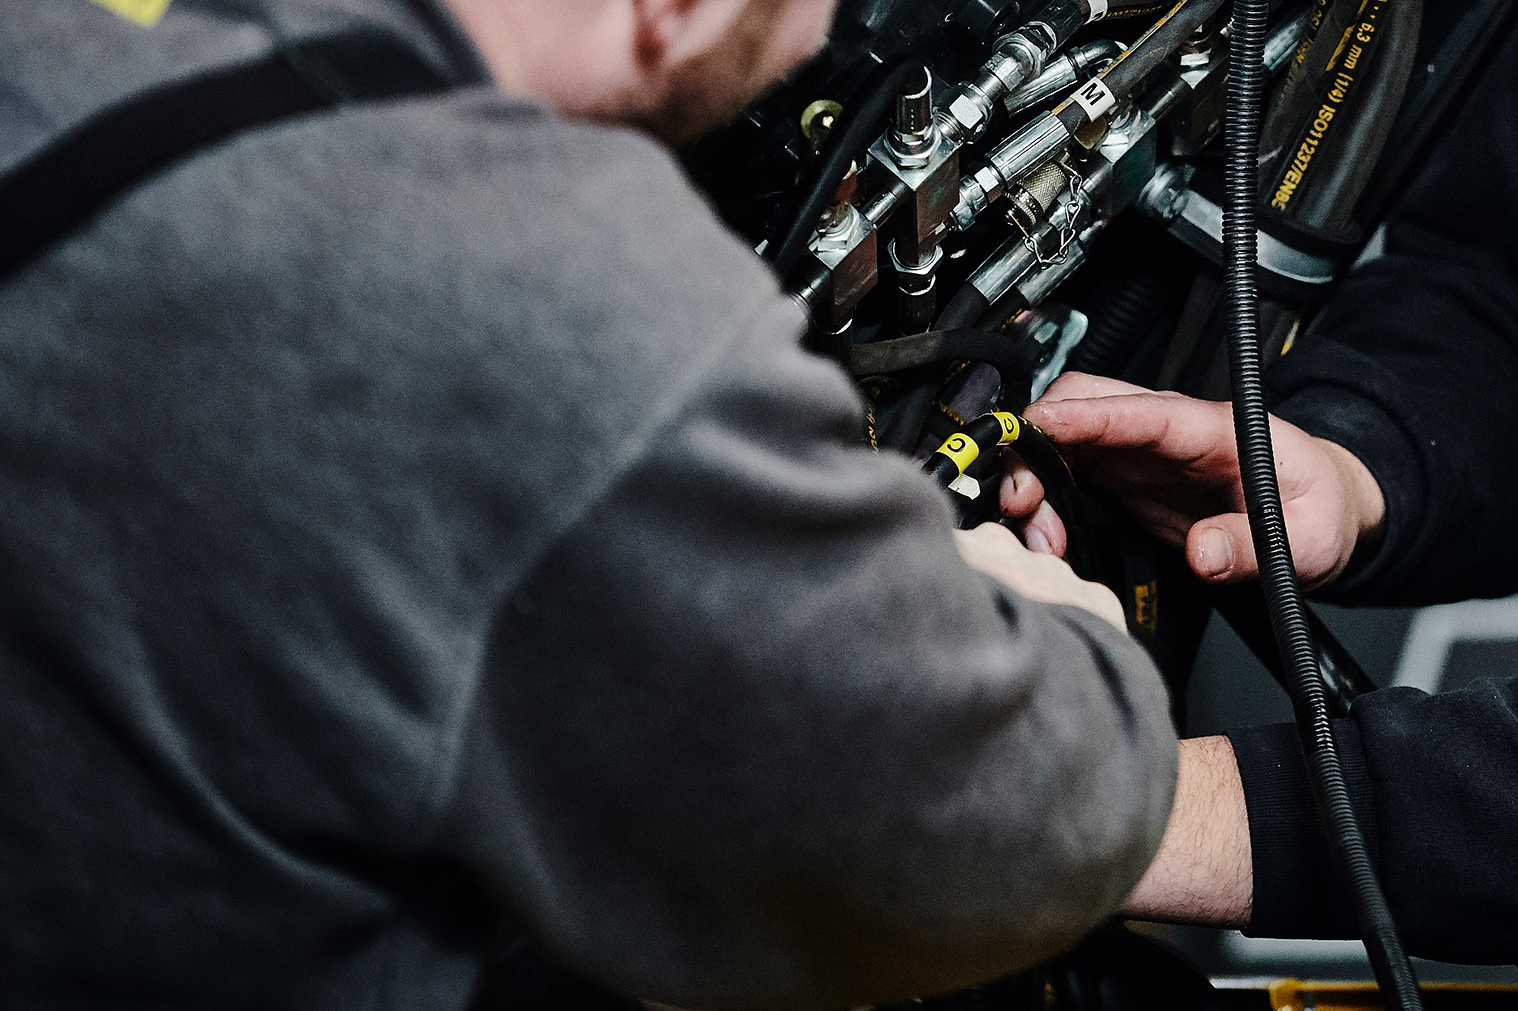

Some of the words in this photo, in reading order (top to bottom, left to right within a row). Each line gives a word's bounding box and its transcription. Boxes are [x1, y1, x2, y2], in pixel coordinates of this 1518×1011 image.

[1345, 43, 1365, 72] mm
[1081, 83, 1106, 107] M
[1328, 73, 1354, 103] (1/4)
[947, 437, 966, 453] C
